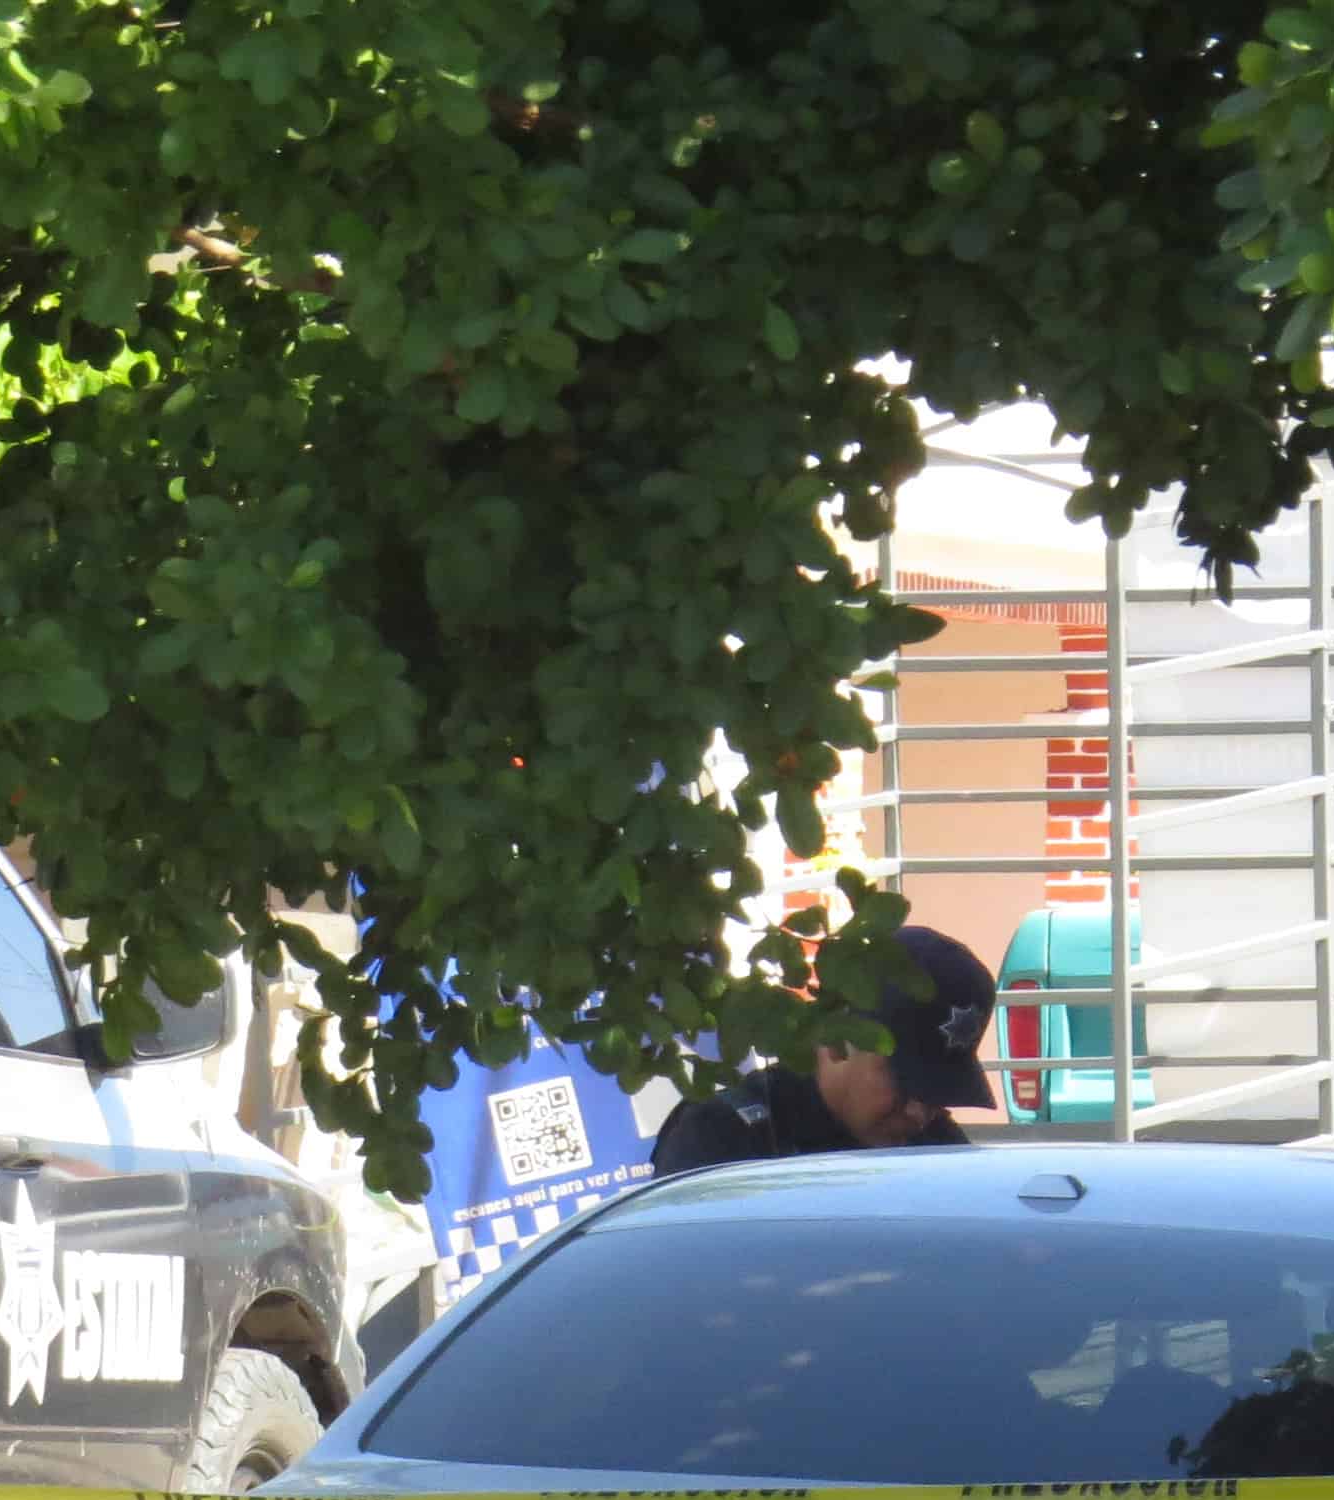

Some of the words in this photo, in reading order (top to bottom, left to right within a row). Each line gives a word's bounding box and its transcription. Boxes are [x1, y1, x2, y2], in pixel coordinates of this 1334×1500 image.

[549, 1178, 585, 1202] para
[587, 1171, 611, 1189] ver
[613, 1164, 629, 1182] el
[61, 1249, 185, 1382] ESTATAL
